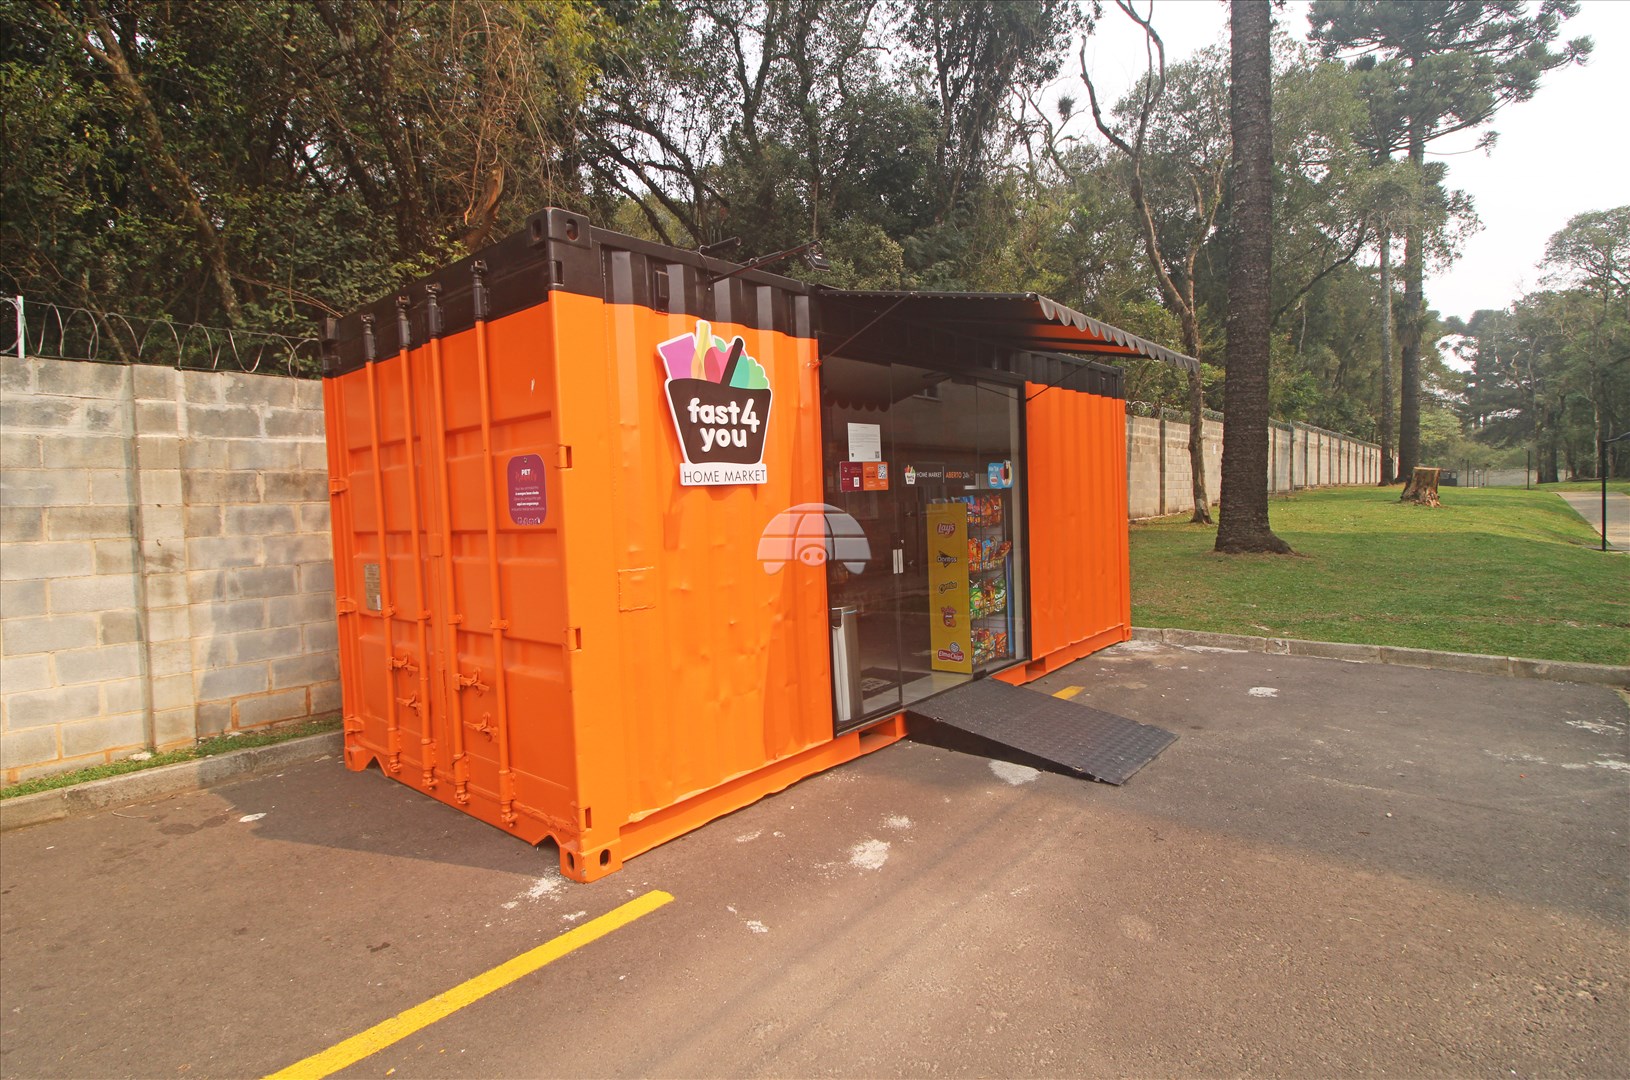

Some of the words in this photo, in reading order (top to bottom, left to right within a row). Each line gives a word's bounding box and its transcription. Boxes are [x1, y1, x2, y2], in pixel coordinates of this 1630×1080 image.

[700, 427, 747, 452] you
[521, 468, 531, 476] PET
[683, 470, 718, 483] HOME
[724, 469, 765, 482] MARKET
